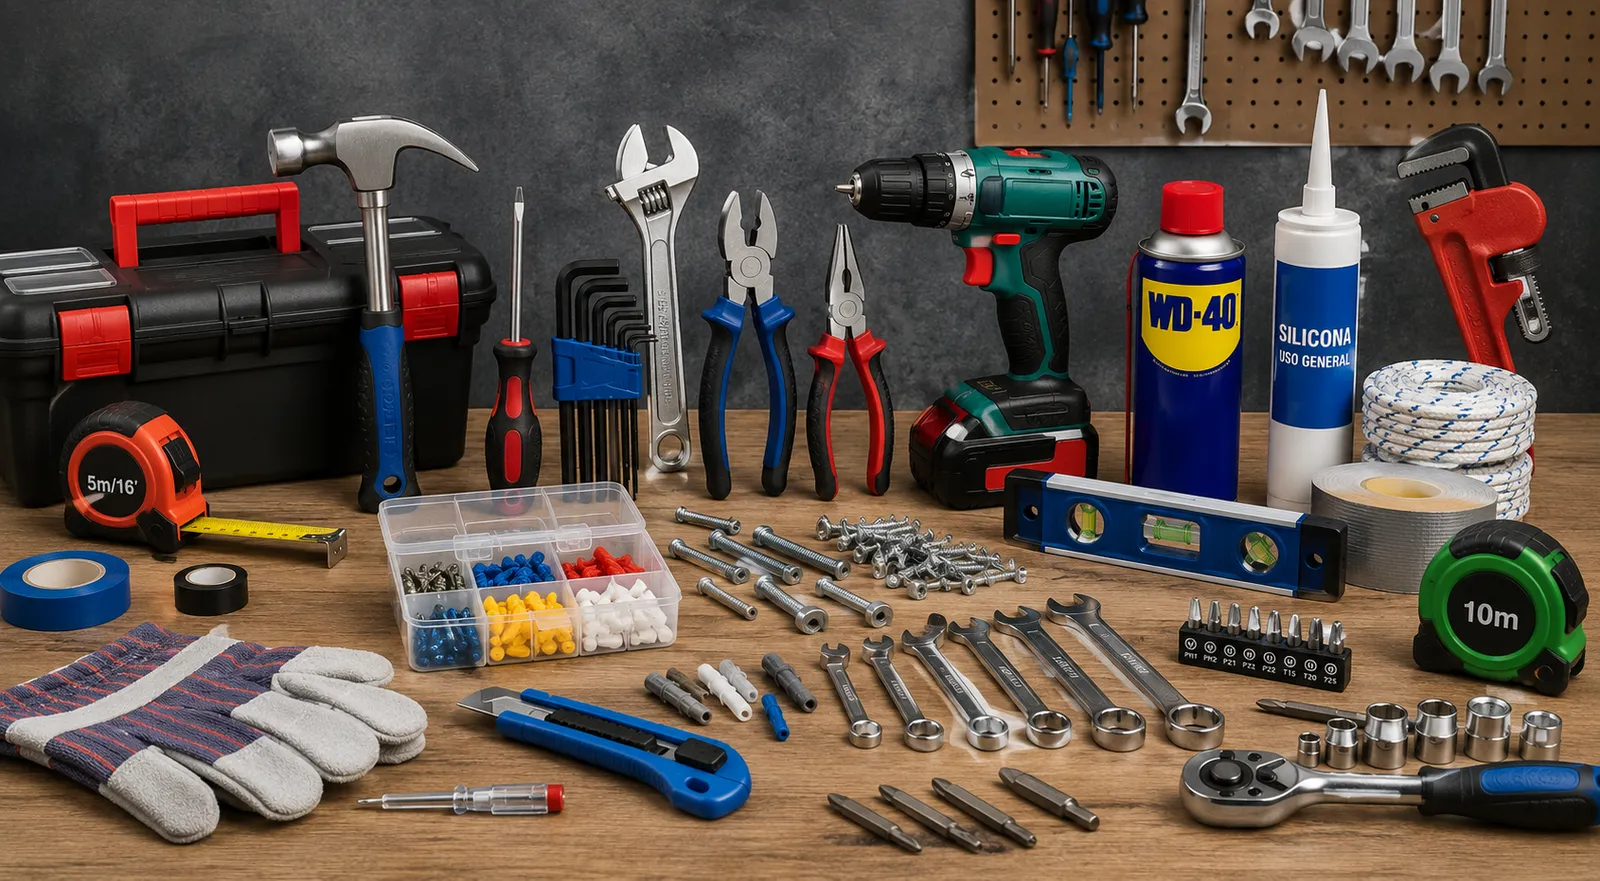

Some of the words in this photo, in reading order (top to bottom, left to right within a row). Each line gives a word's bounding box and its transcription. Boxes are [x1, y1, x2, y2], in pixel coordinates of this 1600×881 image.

[1148, 290, 1237, 332] WD-40
[1279, 324, 1351, 348] SILICONA
[1280, 349, 1299, 366] USO
[1302, 353, 1350, 369] GENERAL
[87, 474, 138, 495] 5m/16'
[1464, 600, 1519, 631] 10m
